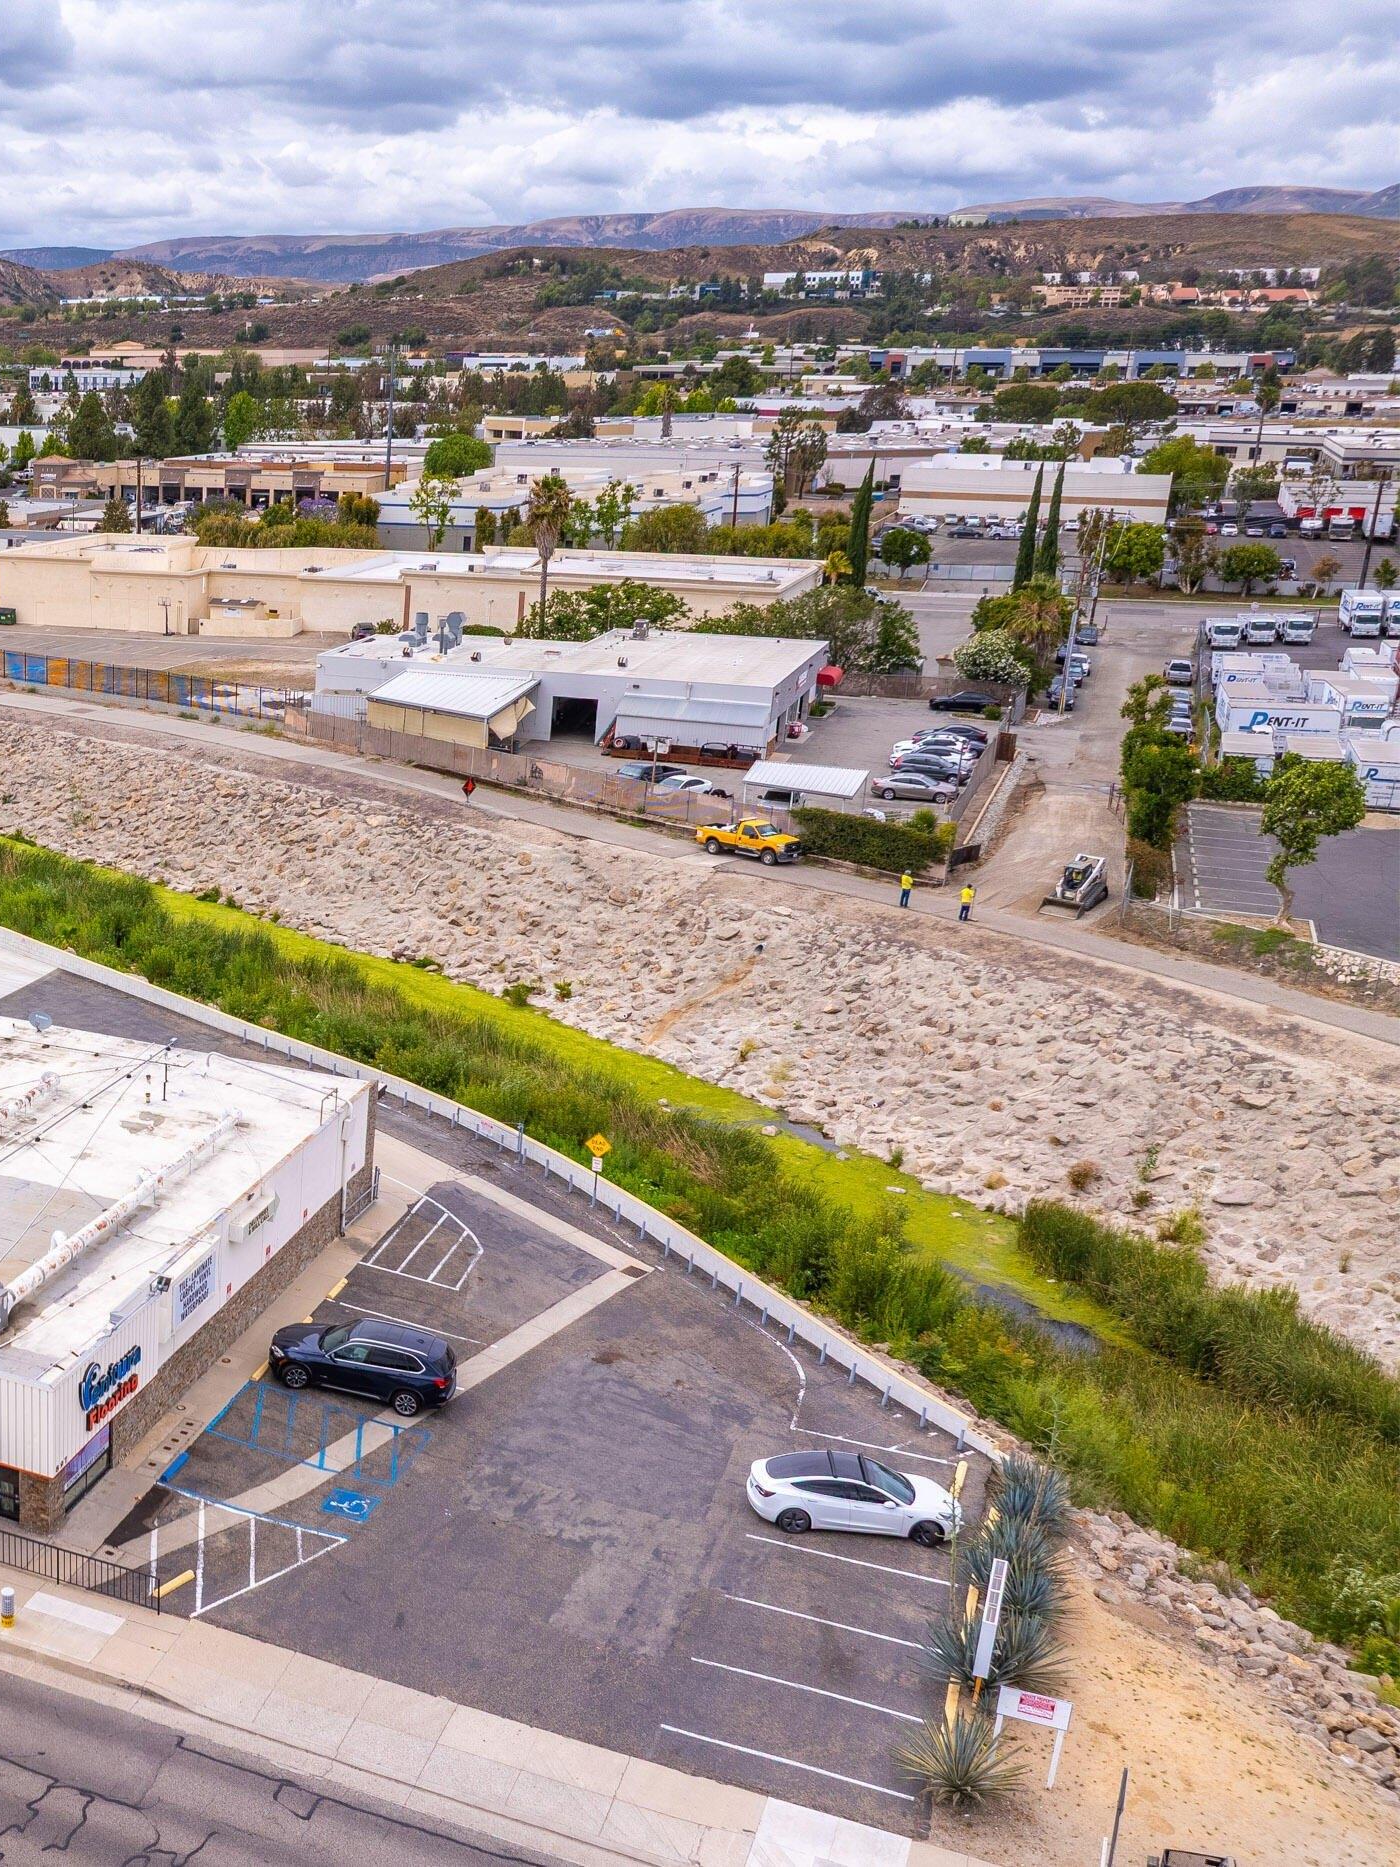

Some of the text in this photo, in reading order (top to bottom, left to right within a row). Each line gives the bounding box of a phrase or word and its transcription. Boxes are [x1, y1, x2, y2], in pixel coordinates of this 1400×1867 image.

[591, 1139, 606, 1147] DEAD
[179, 1255, 212, 1294] TILE LAMINATE
[180, 1266, 211, 1302] CARPET VINYL
[181, 1288, 209, 1322] WATERPROOF
[183, 1280, 208, 1310] HARDWOOD
[79, 1344, 141, 1411] Ventura
[86, 1373, 139, 1431] Flooring
